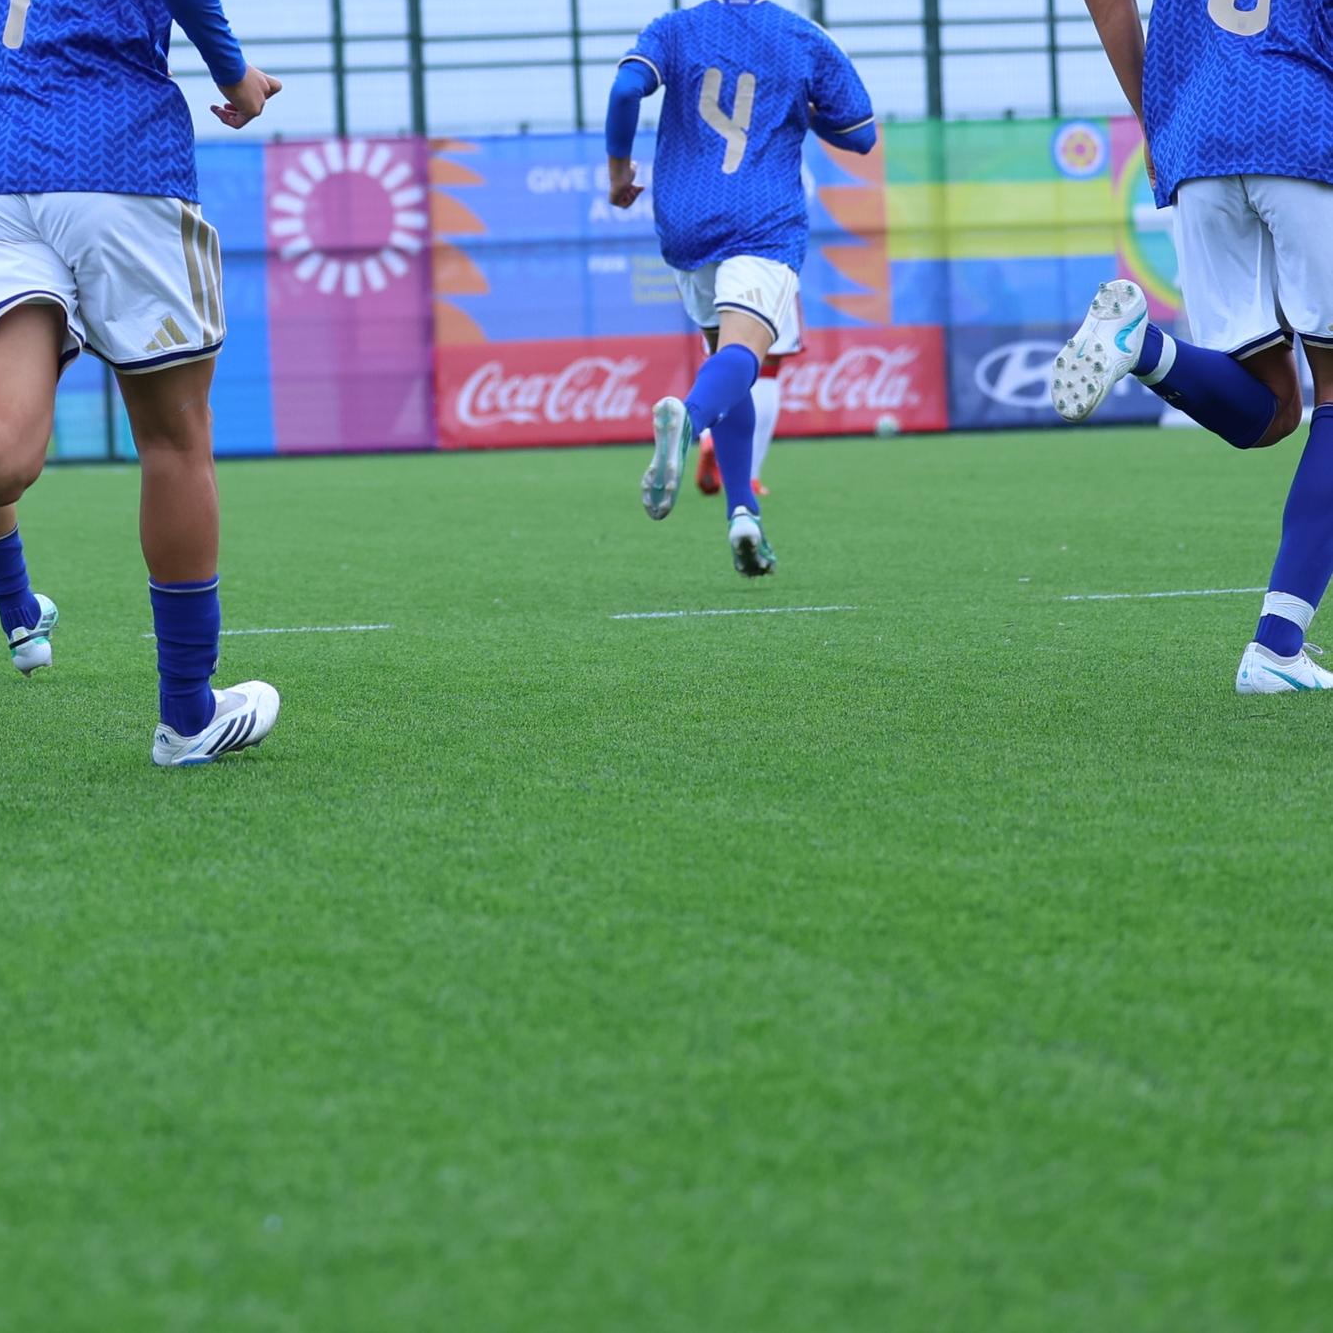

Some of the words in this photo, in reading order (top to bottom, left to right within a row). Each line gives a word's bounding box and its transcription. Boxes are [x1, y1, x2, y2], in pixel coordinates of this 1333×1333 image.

[698, 67, 755, 174] 4
[526, 165, 588, 193] GIVE
[457, 355, 647, 426] Coca-Cola
